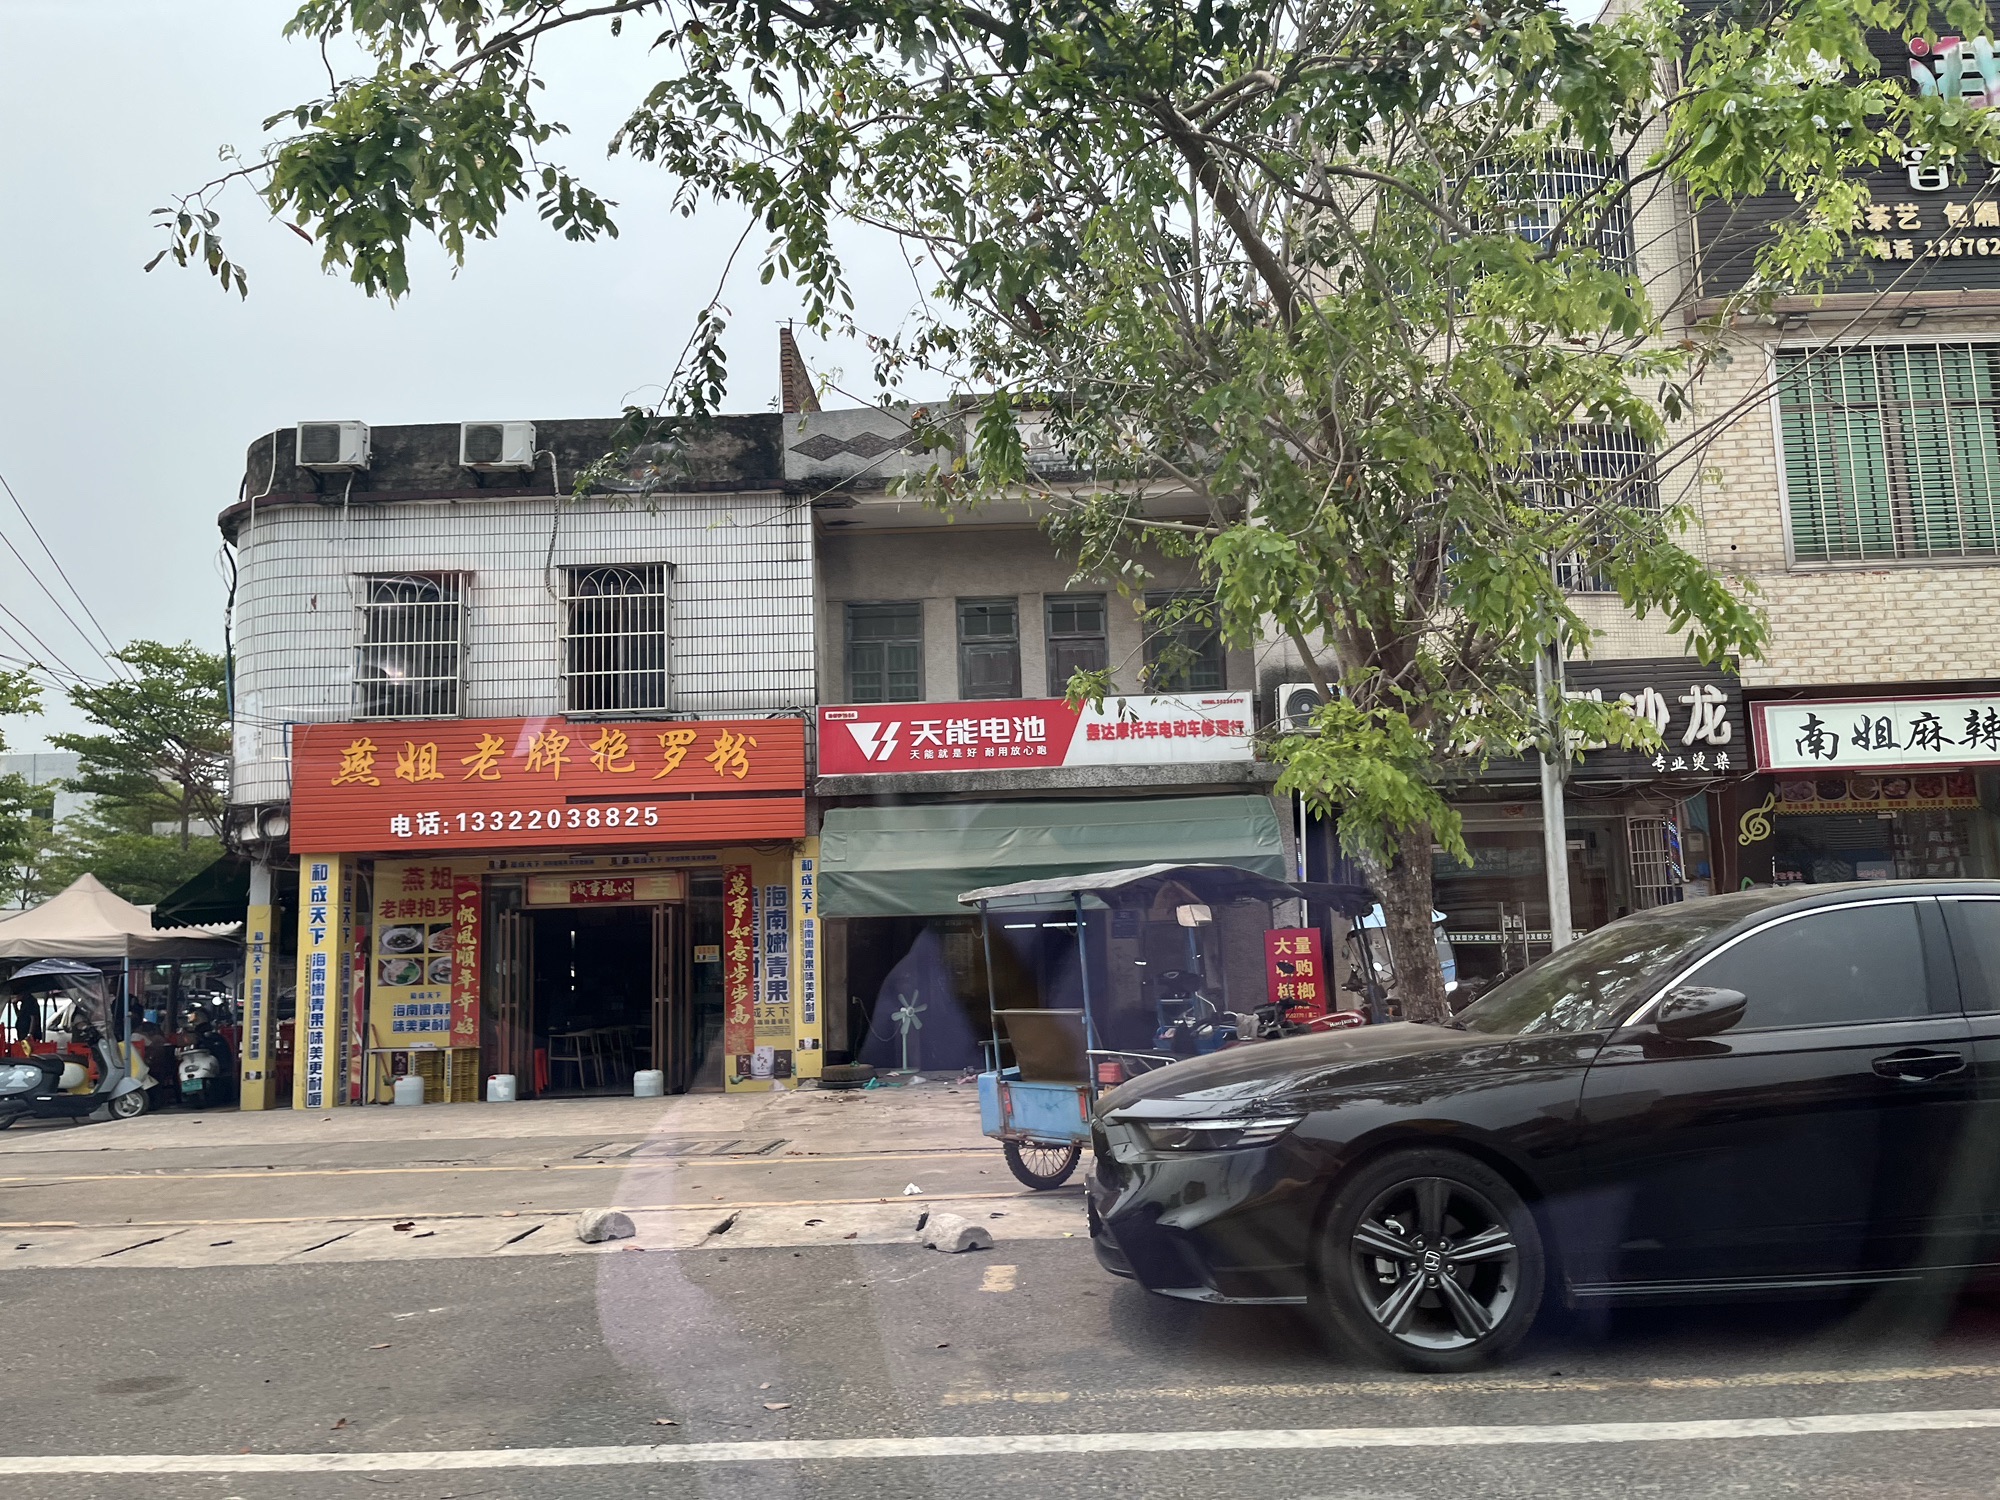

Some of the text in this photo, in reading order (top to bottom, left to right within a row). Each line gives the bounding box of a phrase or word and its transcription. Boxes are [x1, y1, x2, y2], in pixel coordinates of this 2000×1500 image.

[1806, 203, 1922, 232] 茶艺
[910, 715, 1046, 747] 天能电池
[330, 727, 758, 787] 燕姐老牌抱罗粉
[909, 744, 1048, 760] 天能就是好 耐用放心跑
[1651, 751, 1731, 773] 专业烫染
[402, 866, 453, 891] 燕姐
[801, 859, 814, 914] 和成天下
[309, 863, 329, 945] 和成天下
[765, 885, 789, 1002] 海南嫩青果
[1274, 936, 1312, 955] 大量
